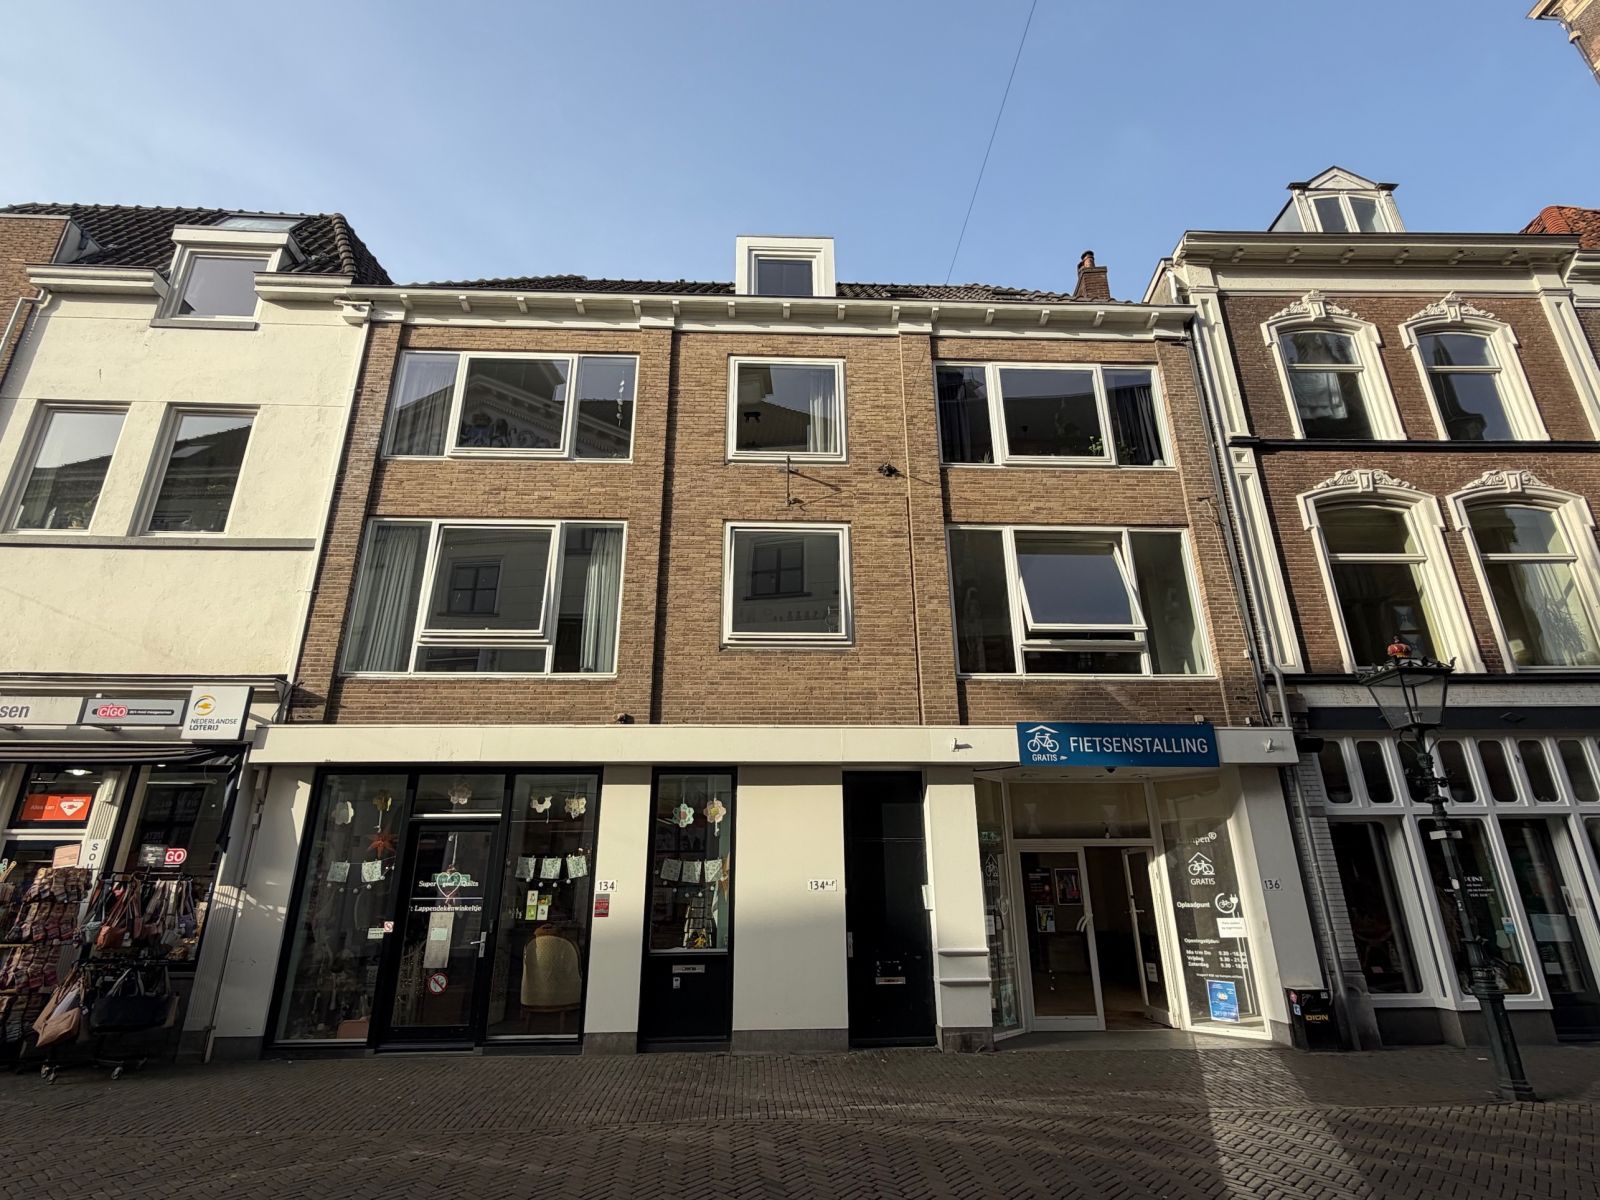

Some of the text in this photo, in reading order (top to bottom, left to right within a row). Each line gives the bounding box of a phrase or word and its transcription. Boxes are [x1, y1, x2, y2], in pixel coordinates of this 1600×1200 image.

[1069, 736, 1208, 754] FIETSENSTALLING
[1032, 753, 1058, 762] GRATIS
[599, 881, 615, 890] 134
[1264, 879, 1280, 889] 136
